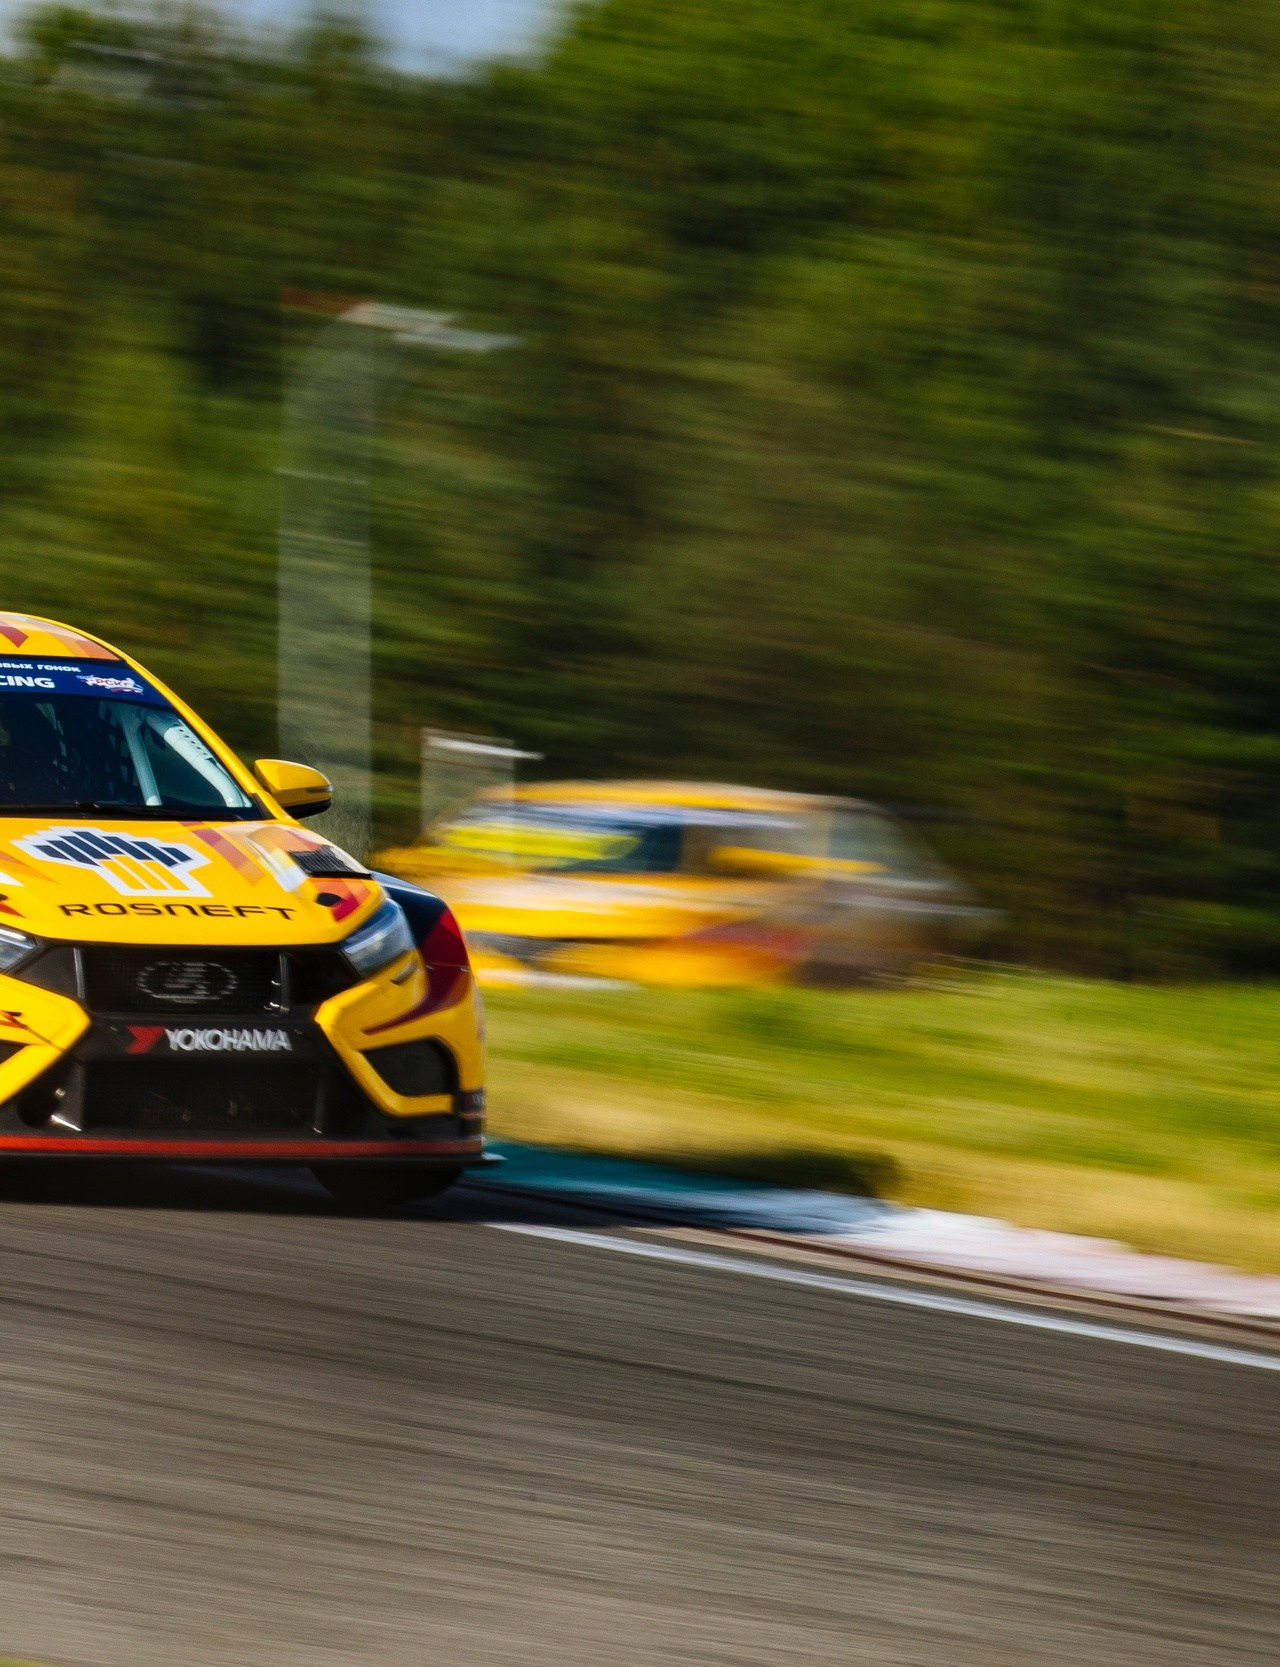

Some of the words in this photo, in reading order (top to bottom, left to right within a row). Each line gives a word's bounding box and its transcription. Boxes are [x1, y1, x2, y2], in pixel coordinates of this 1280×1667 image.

[36, 664, 81, 673] гонок
[58, 902, 297, 921] ROSNEFT
[164, 1028, 294, 1051] YOKOHAMA
